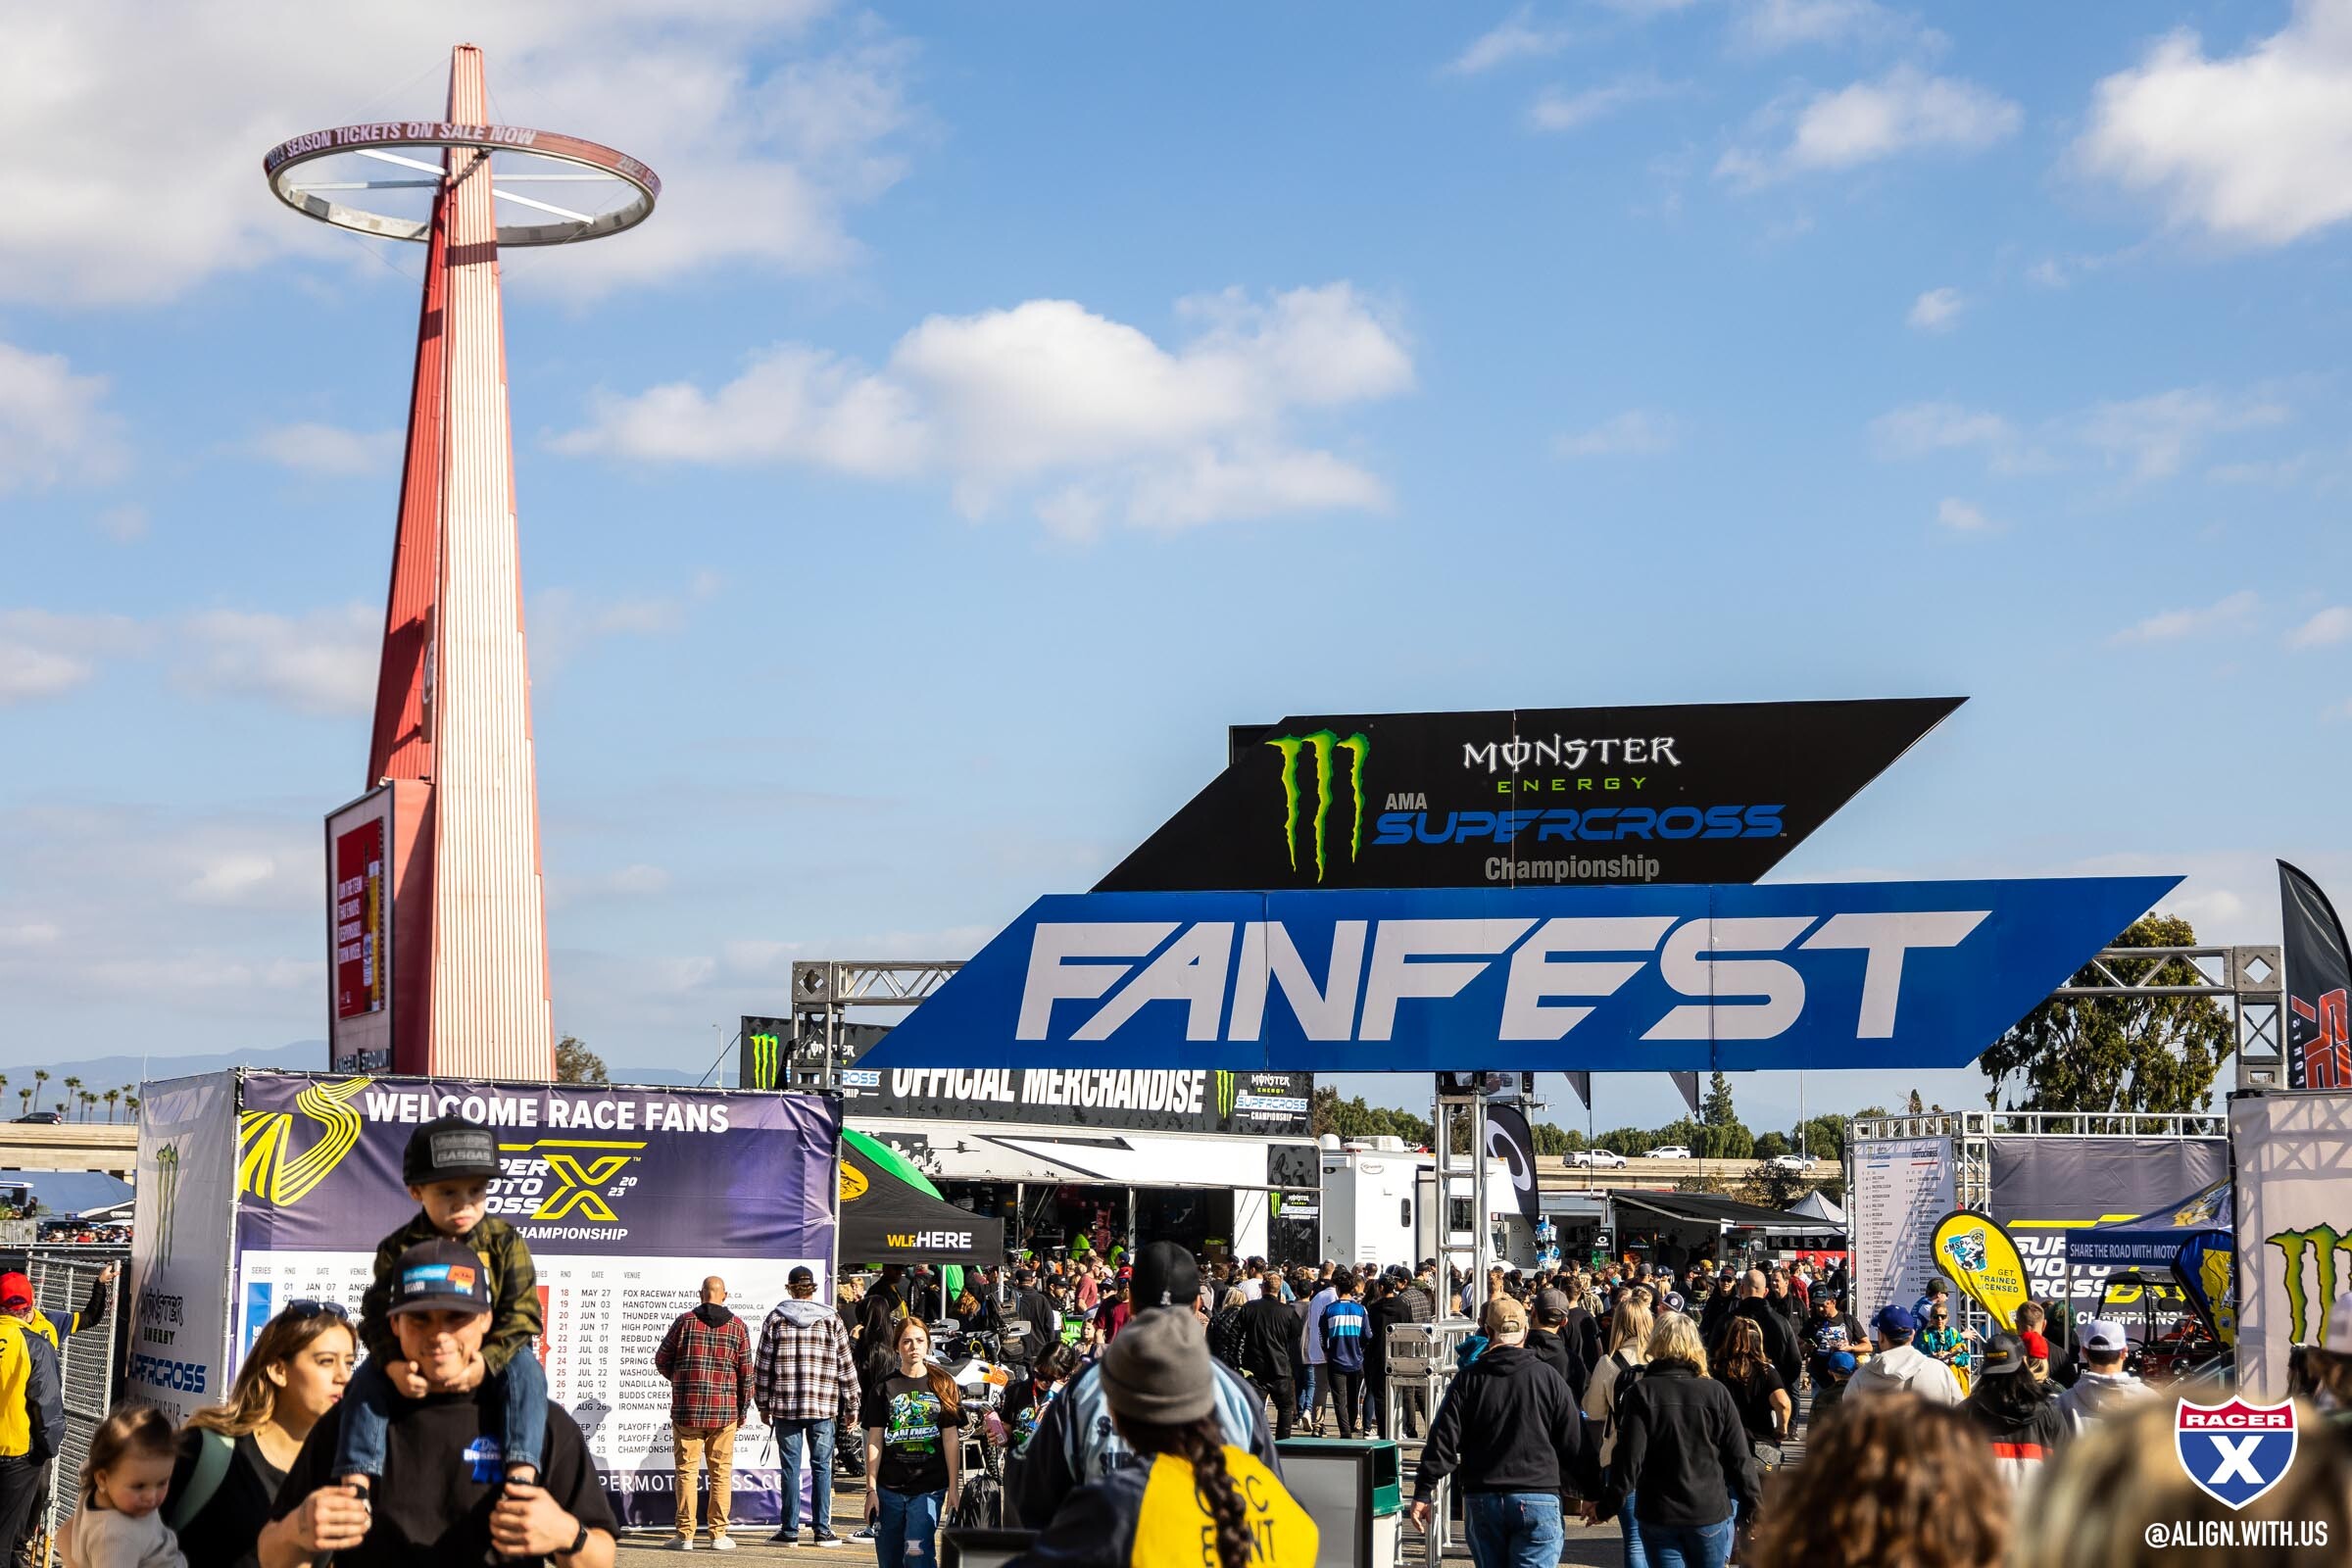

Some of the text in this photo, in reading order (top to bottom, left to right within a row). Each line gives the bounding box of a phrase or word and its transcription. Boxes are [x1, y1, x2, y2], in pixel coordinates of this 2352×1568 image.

[286, 130, 331, 157] SEASON
[335, 122, 401, 144] TICKETS
[406, 122, 434, 138] ON
[439, 123, 486, 139] SALE
[490, 125, 537, 145] NOW
[1462, 734, 1681, 773] MONSTER
[1497, 776, 1646, 794] ENERGY
[1385, 793, 1427, 809] AMA
[1372, 805, 1787, 845] SUPERCROSS
[1485, 855, 1659, 884] Championship
[1014, 910, 1992, 1041] FANFEST
[1251, 1073, 1290, 1087] MONSTER
[892, 1068, 1206, 1113] OFFICIAL MERCHANDISE
[1236, 1097, 1307, 1110] SUPERCROSS
[365, 1093, 729, 1133] WELCOME RACE FANS
[1250, 1112, 1293, 1121] CHAMPIONSHIP
[619, 1177, 638, 1186] 20
[608, 1188, 625, 1197] 23
[516, 1227, 628, 1240] HAMPIONSHIP
[916, 1232, 972, 1249] HERE
[2070, 1244, 2093, 1257] SHARE
[2094, 1245, 2109, 1257] THE
[2109, 1246, 2132, 1258] ROAD
[2132, 1246, 2152, 1259] WITH
[1980, 1275, 2017, 1285] TRAINED
[1978, 1284, 2019, 1293] LICENSED
